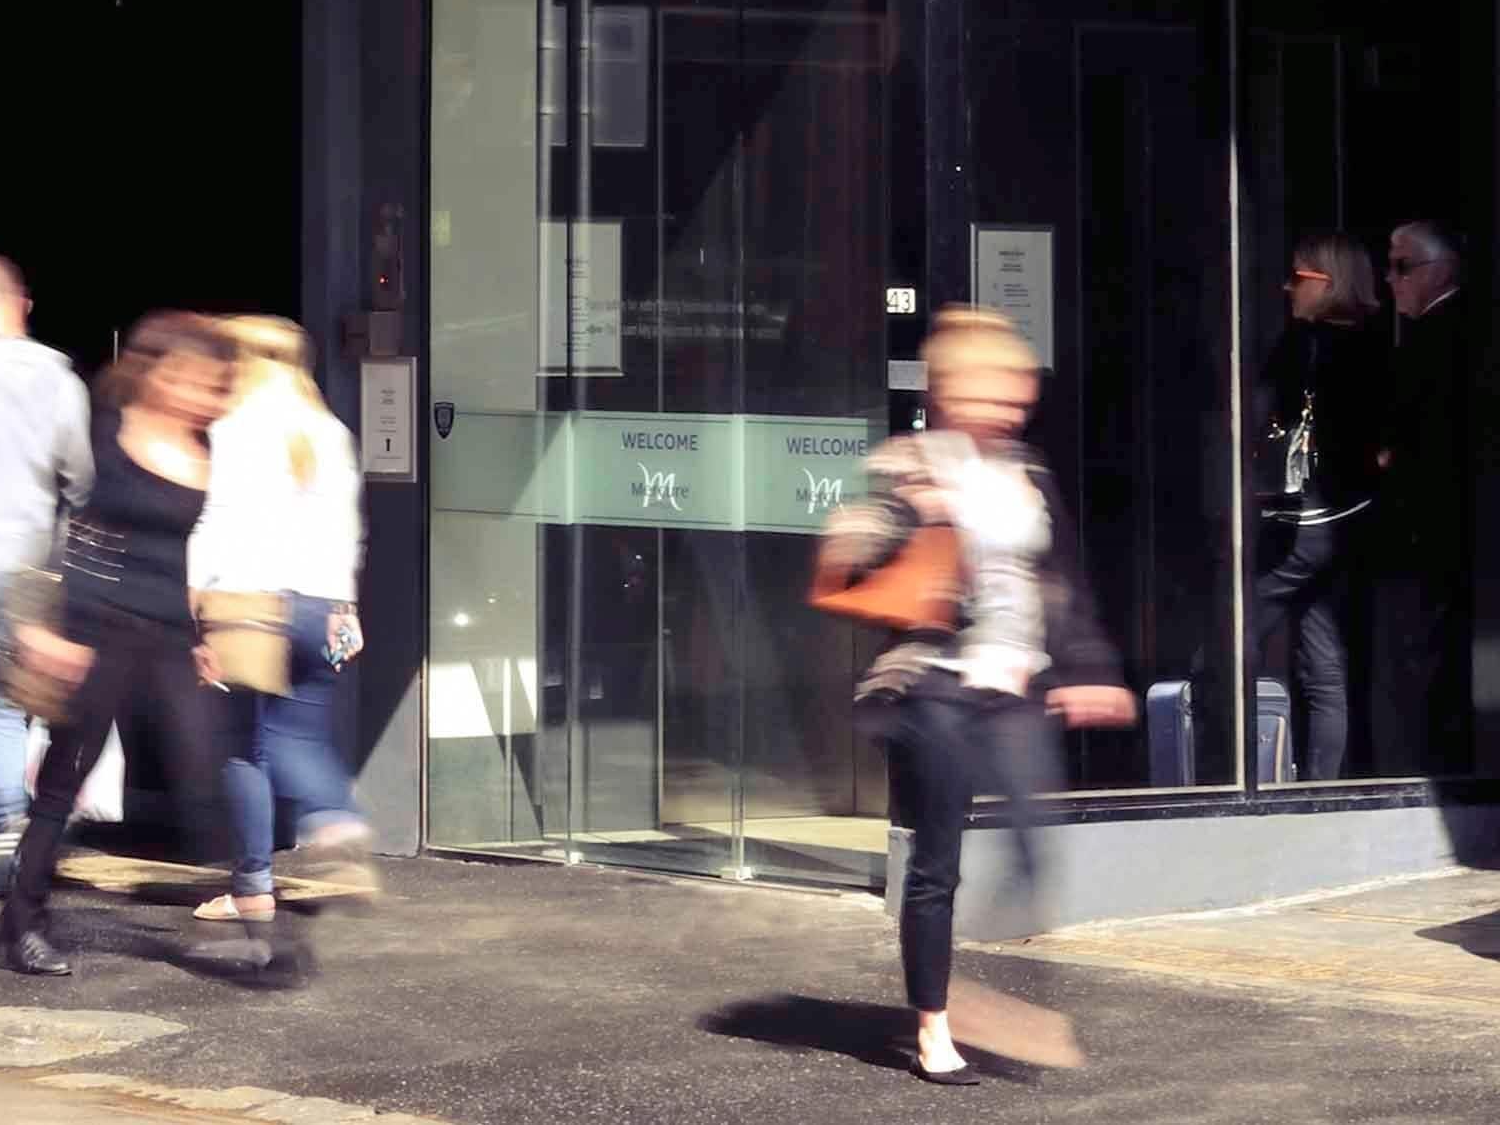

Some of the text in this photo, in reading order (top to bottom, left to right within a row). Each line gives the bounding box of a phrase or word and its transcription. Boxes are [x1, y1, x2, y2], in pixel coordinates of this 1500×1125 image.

[886, 290, 911, 312] 43
[621, 431, 699, 451] WELCOME
[786, 436, 868, 456] WELCOME
